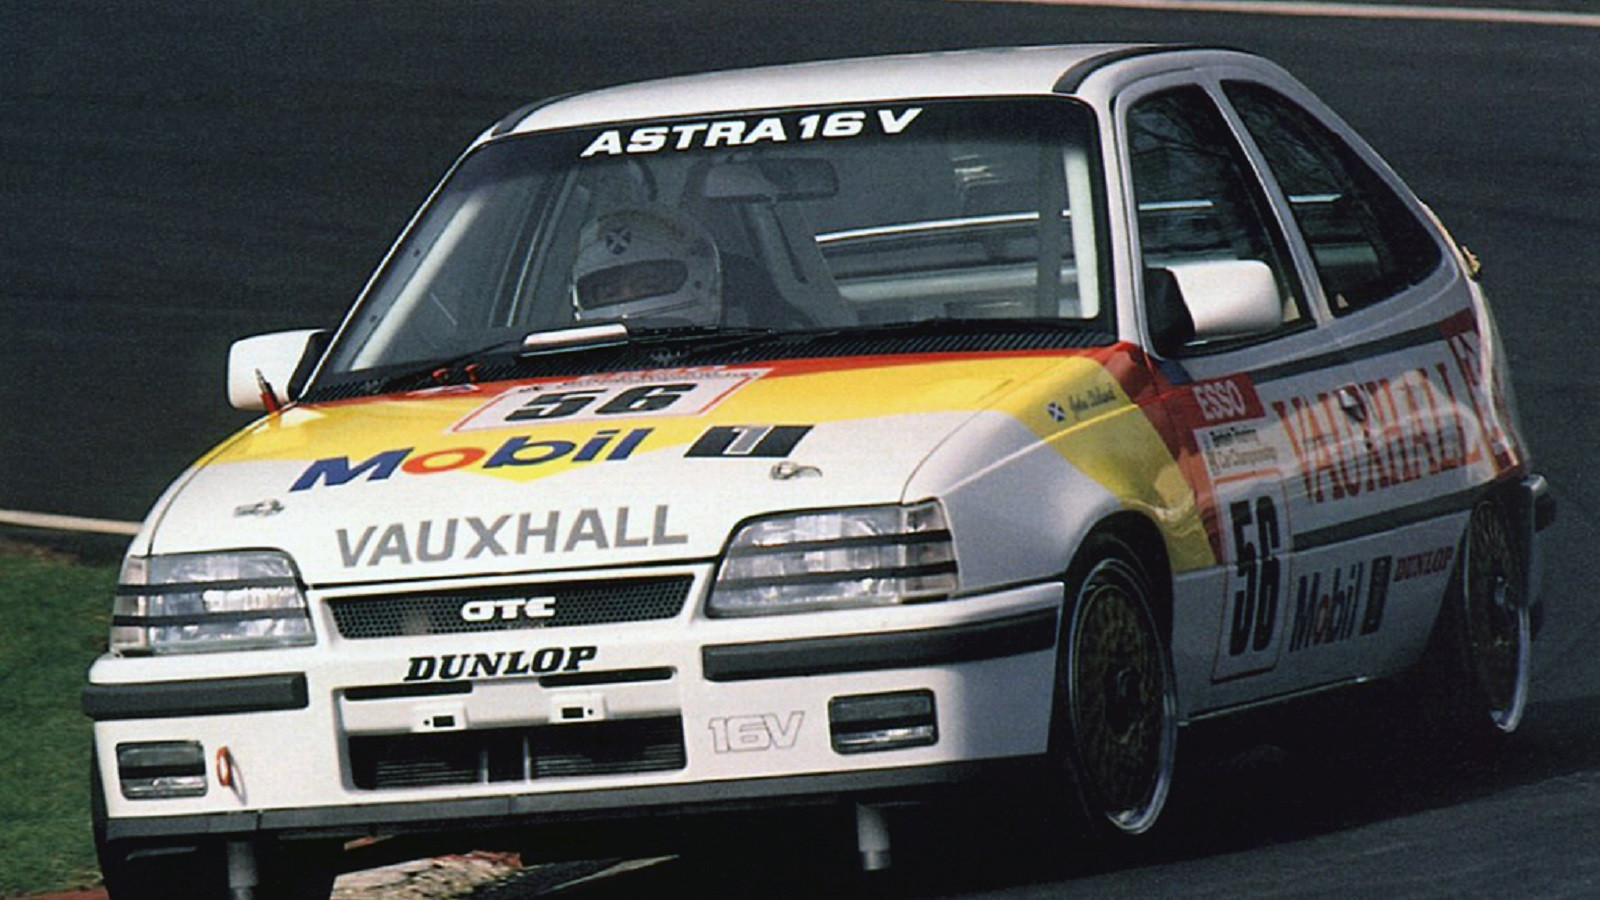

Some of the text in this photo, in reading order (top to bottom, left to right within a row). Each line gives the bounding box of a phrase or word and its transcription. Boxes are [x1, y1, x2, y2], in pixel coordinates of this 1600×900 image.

[580, 118, 787, 157] ASTRA
[799, 111, 866, 139] 16
[504, 383, 699, 422] 56
[1193, 379, 1246, 420] ESSO
[1271, 361, 1482, 504] VAUXHALL
[289, 428, 653, 492] Mobil
[335, 504, 689, 568] VAUXHALL
[1229, 495, 1281, 656] 56
[1393, 545, 1455, 583] DUNLOP
[461, 596, 555, 622] GTC
[1288, 561, 1364, 653] Mobil
[403, 646, 597, 682] DUNLOP
[708, 711, 804, 754] 16V
